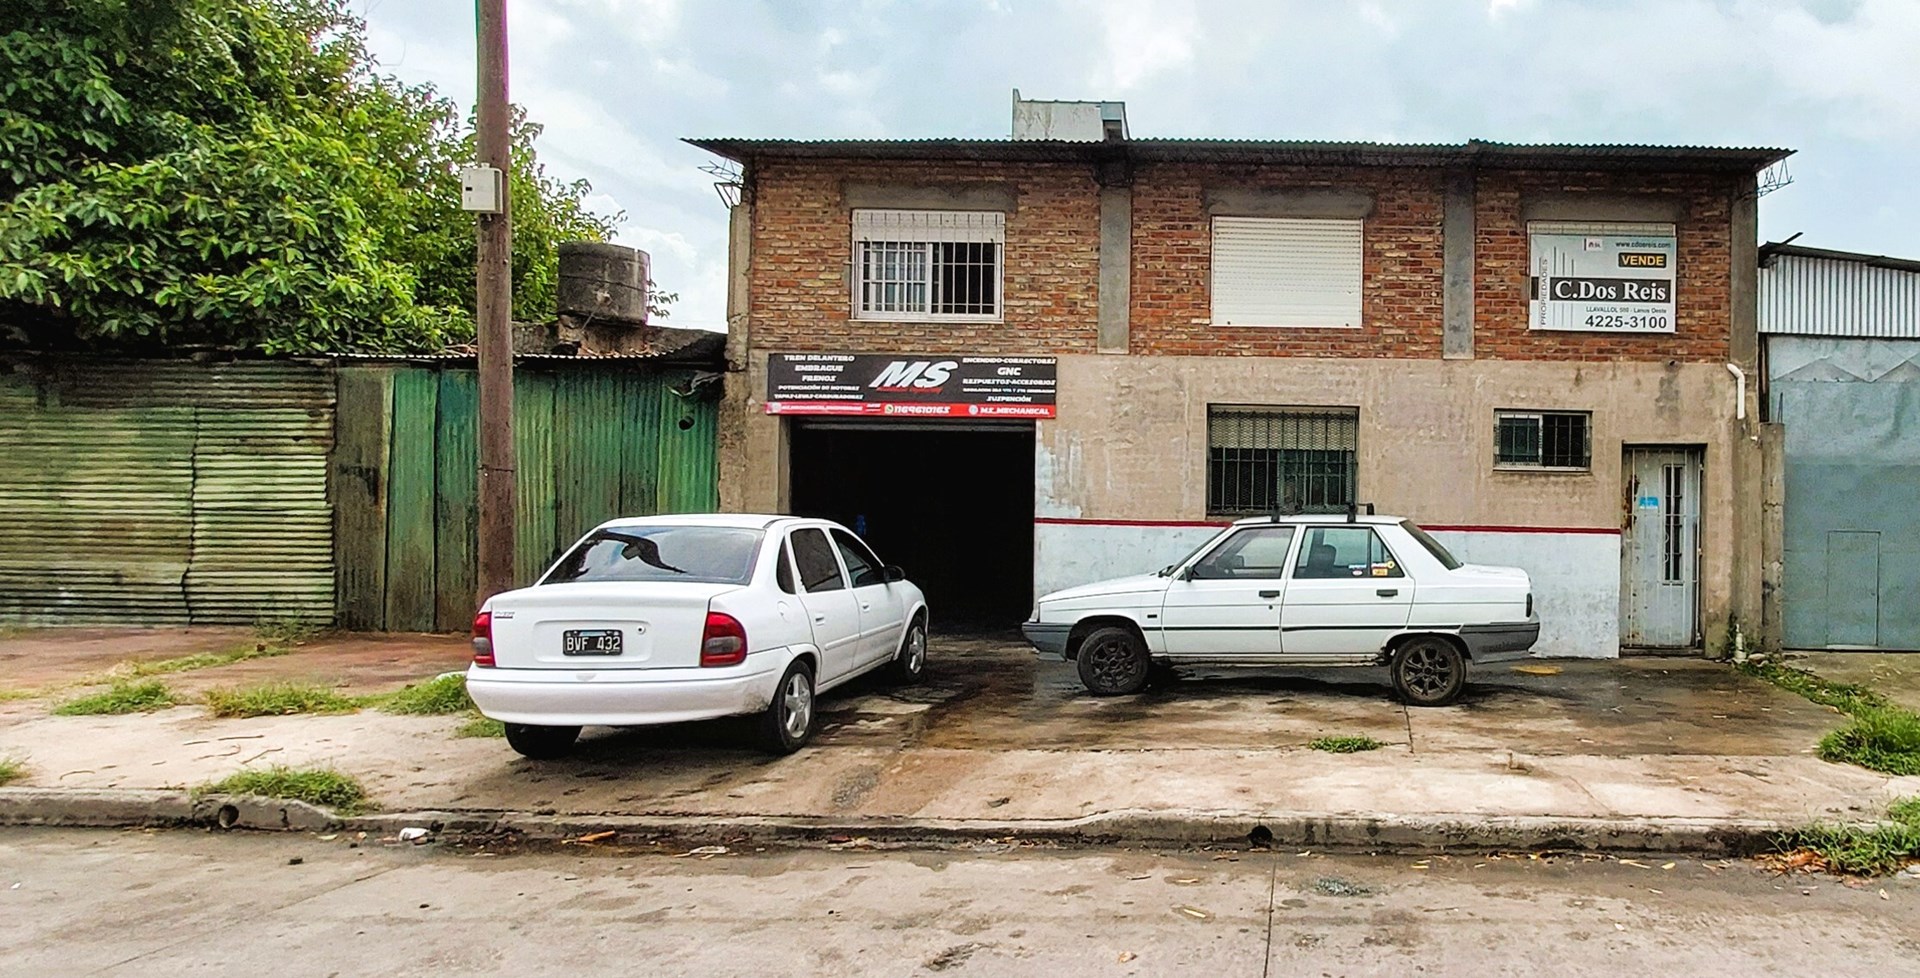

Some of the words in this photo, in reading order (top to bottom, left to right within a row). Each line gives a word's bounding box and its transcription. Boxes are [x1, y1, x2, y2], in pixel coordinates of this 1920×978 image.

[1621, 255, 1665, 266] VENDE
[1554, 280, 1617, 299] C.Dos
[1622, 282, 1666, 300] Reis
[1585, 315, 1667, 328] 4225-3100
[868, 361, 959, 388] MS
[997, 367, 1021, 375] GNC
[566, 637, 589, 651] BVF
[596, 637, 620, 650] 432
